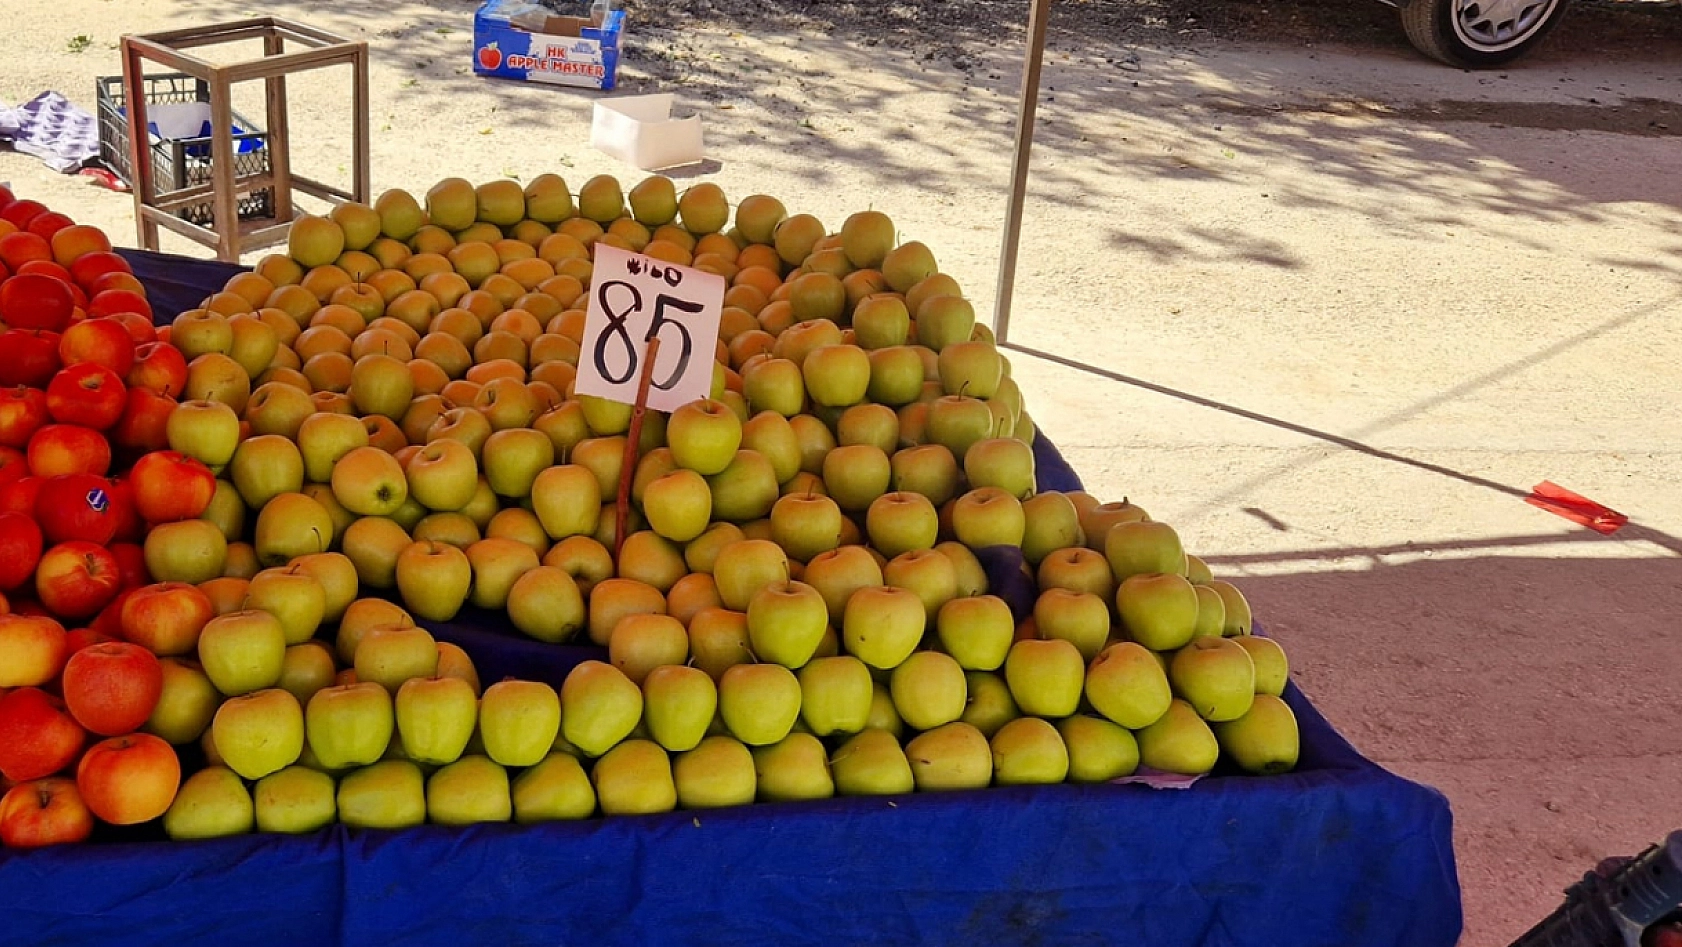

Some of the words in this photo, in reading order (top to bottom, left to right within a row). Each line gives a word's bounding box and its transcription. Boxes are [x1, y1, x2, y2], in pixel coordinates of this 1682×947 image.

[547, 46, 566, 58] HK
[508, 55, 548, 69] APPLE
[553, 61, 605, 77] MASTER
[594, 280, 704, 391] 85
